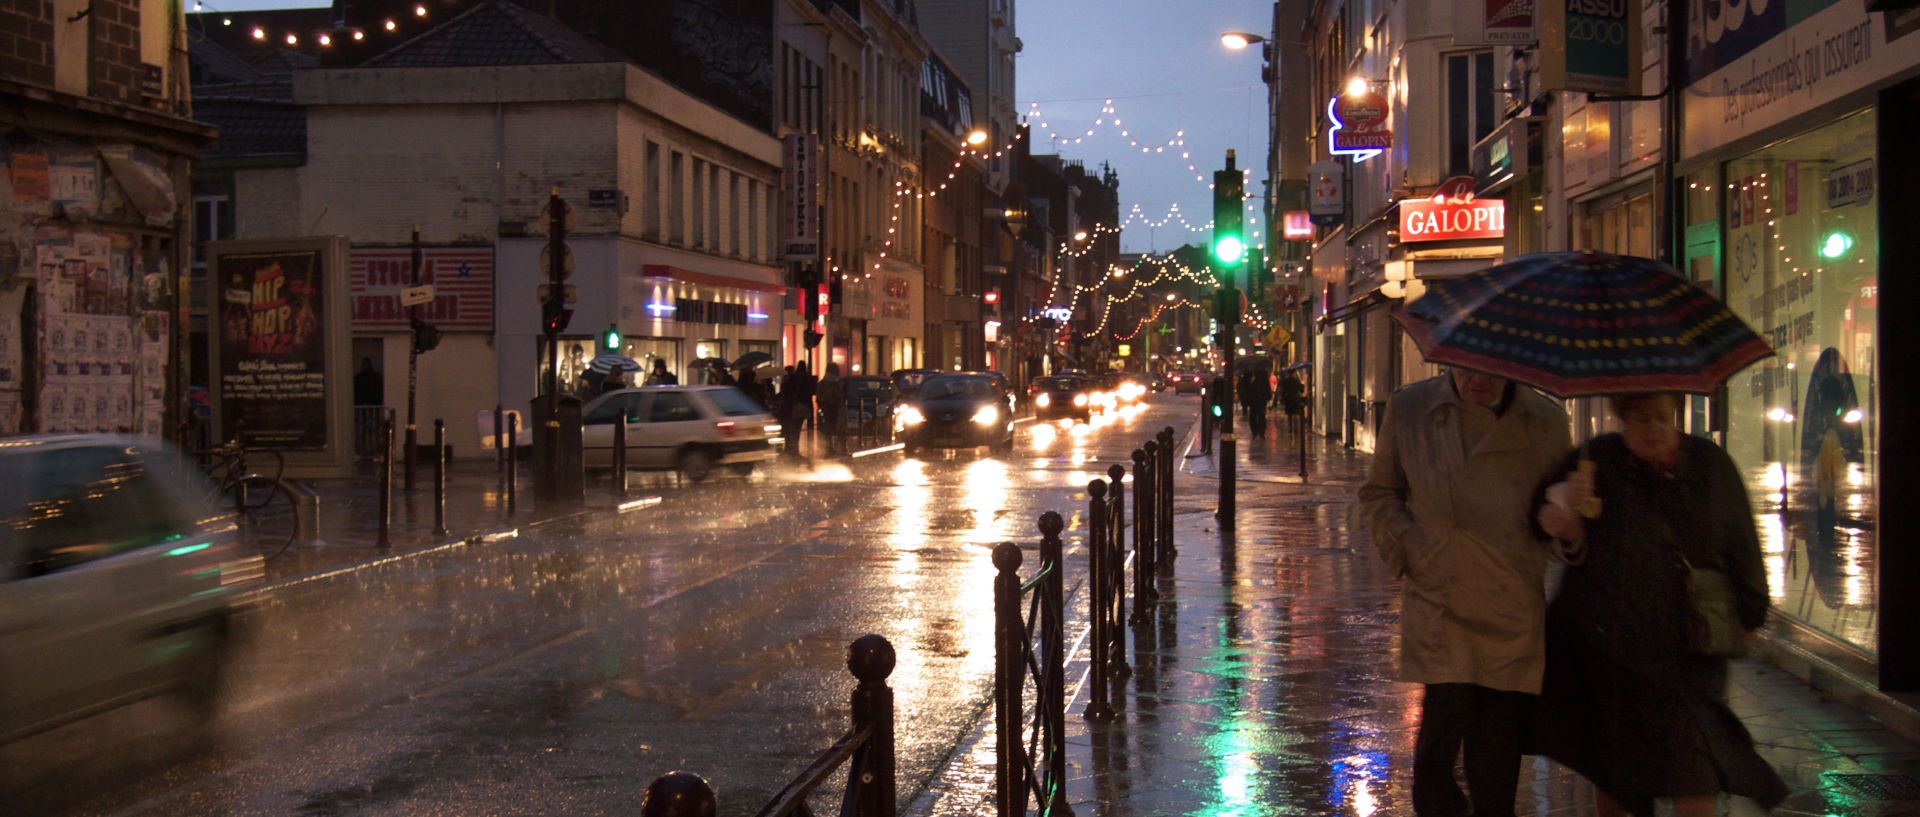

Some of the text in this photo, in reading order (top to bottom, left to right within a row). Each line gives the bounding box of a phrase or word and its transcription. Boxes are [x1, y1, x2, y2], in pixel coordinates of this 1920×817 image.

[1568, 17, 1625, 45] 2000
[1723, 19, 1871, 128] Des professionnels qui assurent
[1337, 135, 1388, 147] GALOPIN
[796, 136, 806, 238] STOCKS
[1447, 182, 1475, 205] Le
[367, 260, 434, 285] STOCS
[252, 275, 286, 305] HIP
[253, 305, 293, 336] HOP
